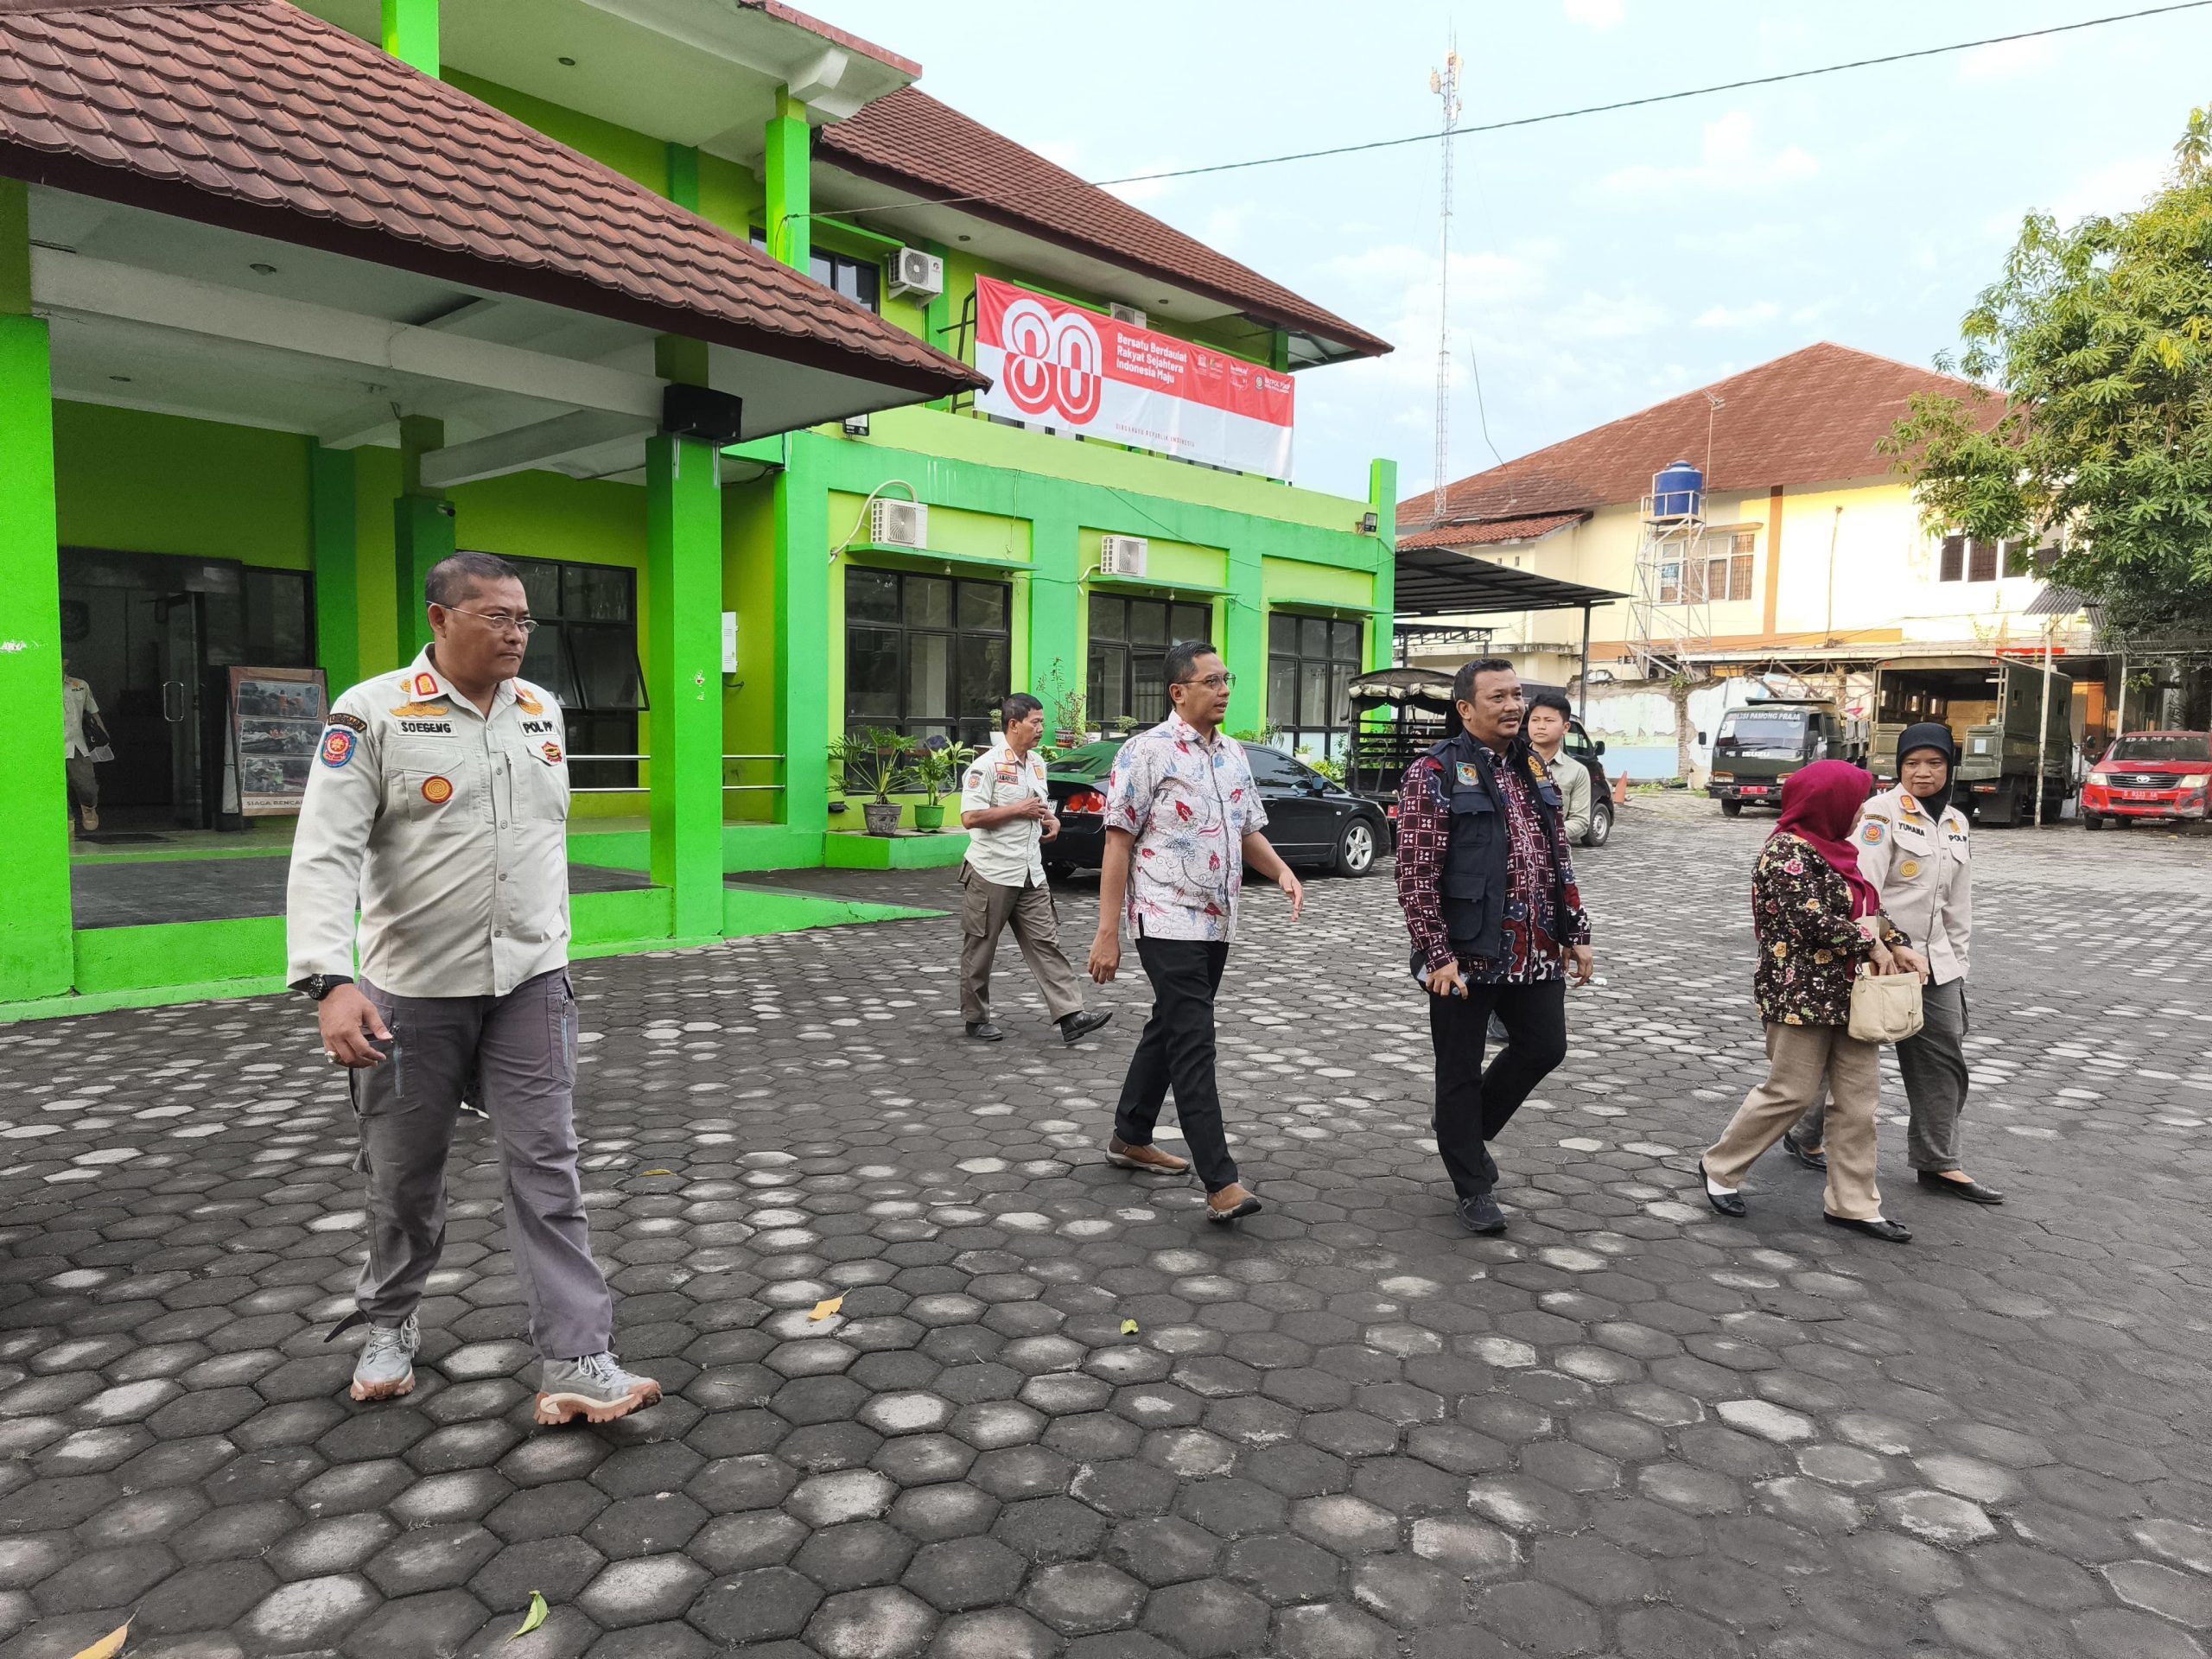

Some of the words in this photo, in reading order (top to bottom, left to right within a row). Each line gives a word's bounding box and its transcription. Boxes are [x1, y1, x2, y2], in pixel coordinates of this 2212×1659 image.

[1117, 332, 1148, 352] Bersatu
[1150, 342, 1187, 363] Berdaulat
[1117, 345, 1145, 363] Rakyat
[1147, 354, 1184, 374] Sejahtera
[1002, 299, 1103, 425] 80
[1116, 358, 1156, 378] Indonesia
[1157, 369, 1174, 385] Maju
[1146, 430, 1168, 442] REPUBLIK
[1170, 436, 1195, 448] INDONESIA
[401, 721, 452, 734] SOEGENG
[523, 721, 543, 734] POL
